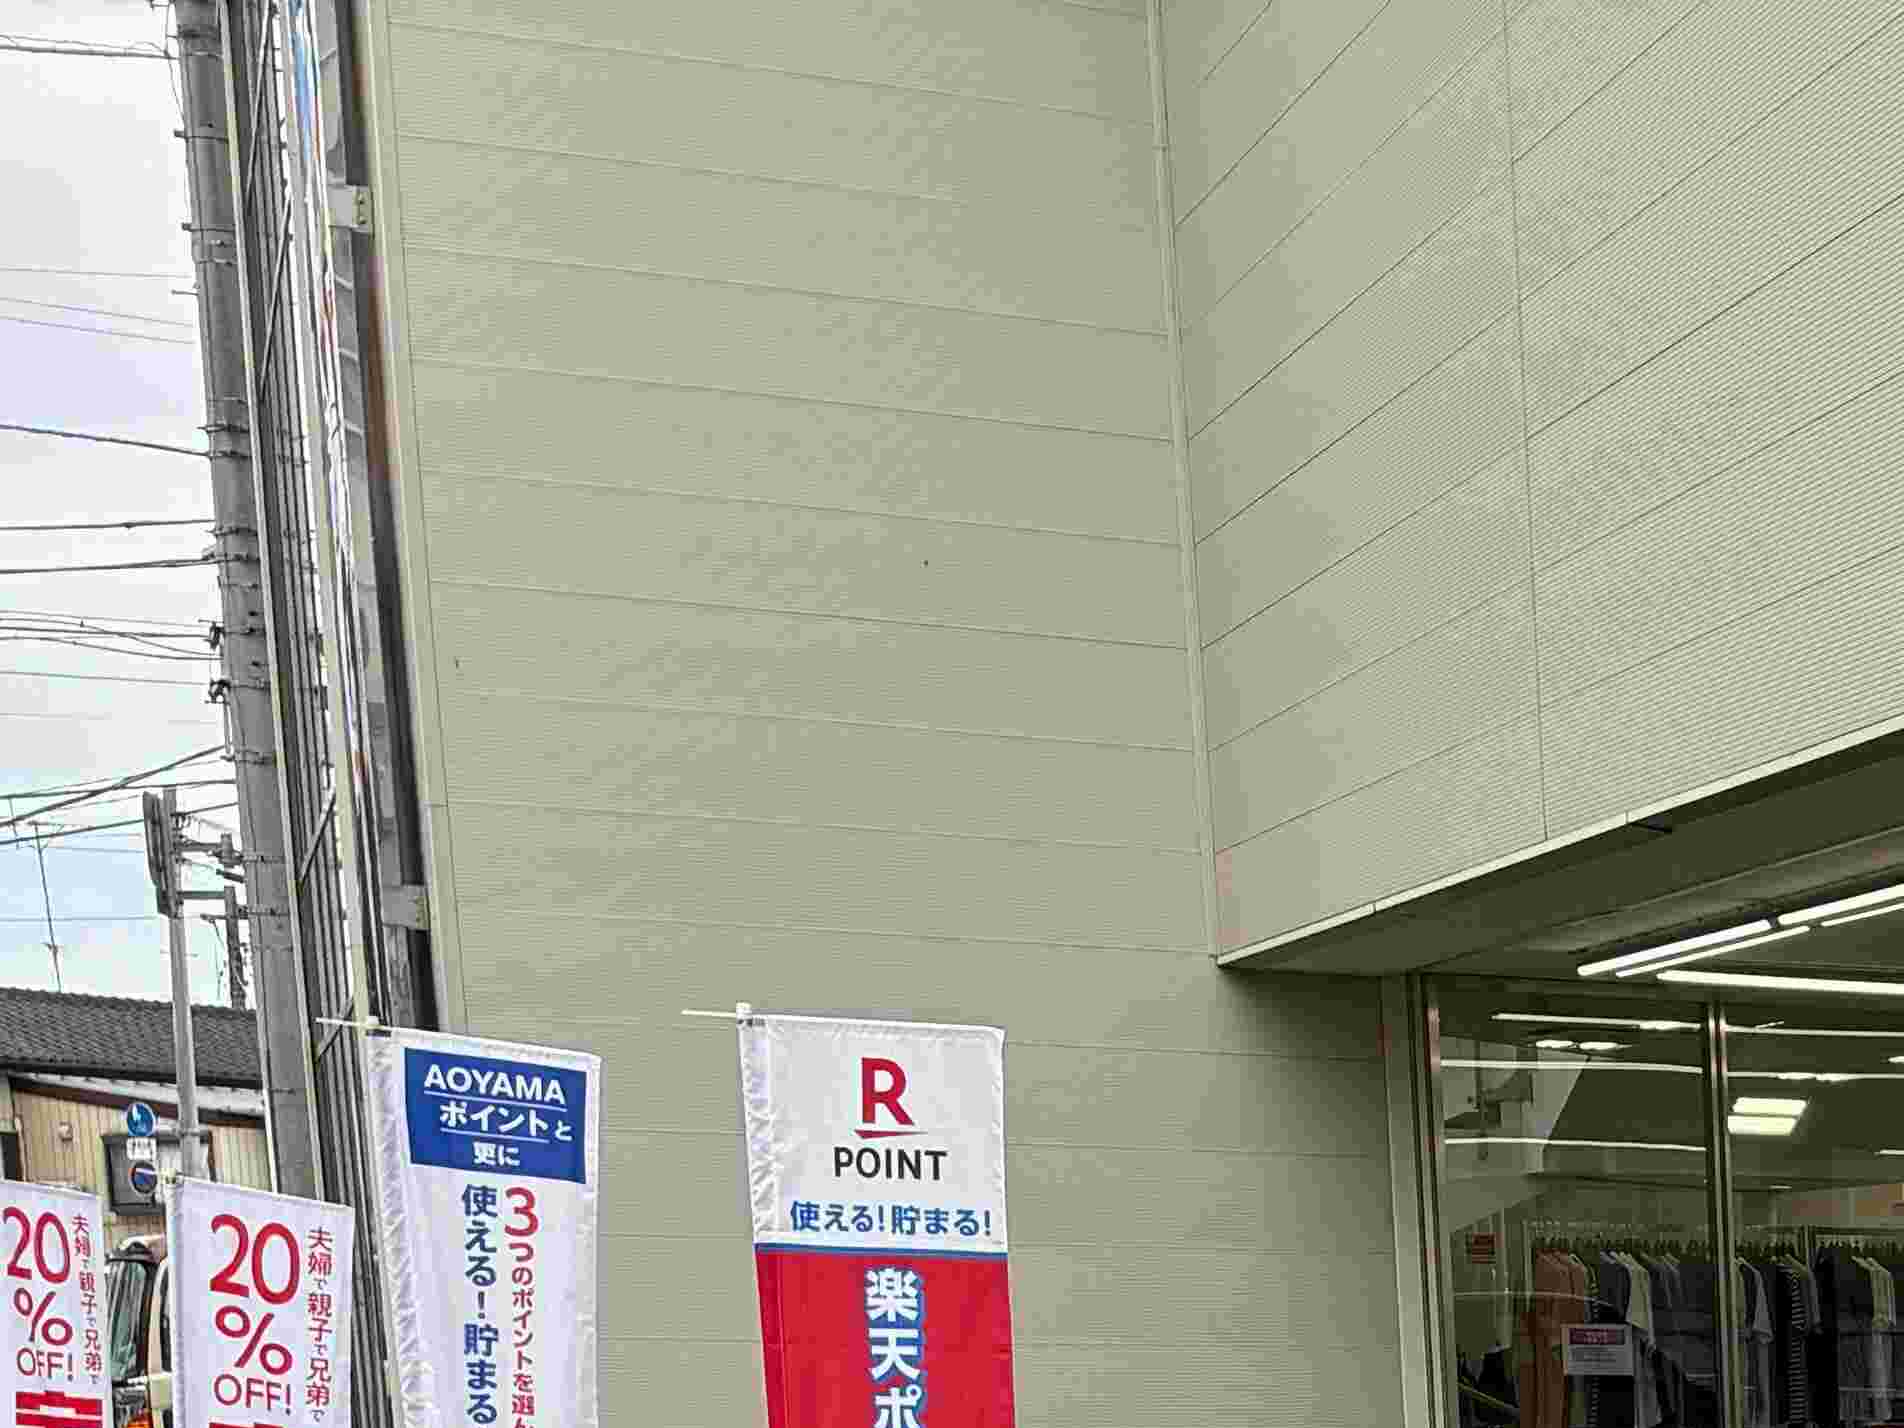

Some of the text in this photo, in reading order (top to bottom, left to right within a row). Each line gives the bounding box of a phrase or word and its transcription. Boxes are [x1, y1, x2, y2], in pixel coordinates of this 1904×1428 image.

[424, 1064, 566, 1104] AOYAMA
[861, 1056, 915, 1126] R
[440, 1101, 573, 1142] ポイントと
[472, 1141, 520, 1167] 更に
[833, 1146, 948, 1181] POINT
[789, 1200, 992, 1237] 使える!貯まる!
[3, 1206, 71, 1284] 20
[210, 1214, 301, 1305] 20
[14, 1288, 73, 1346] %
[305, 1226, 334, 1423] 夫婦で親子で兄弟で
[215, 1305, 293, 1375] %
[16, 1348, 74, 1382] OFF!
[214, 1374, 292, 1416] OFF!
